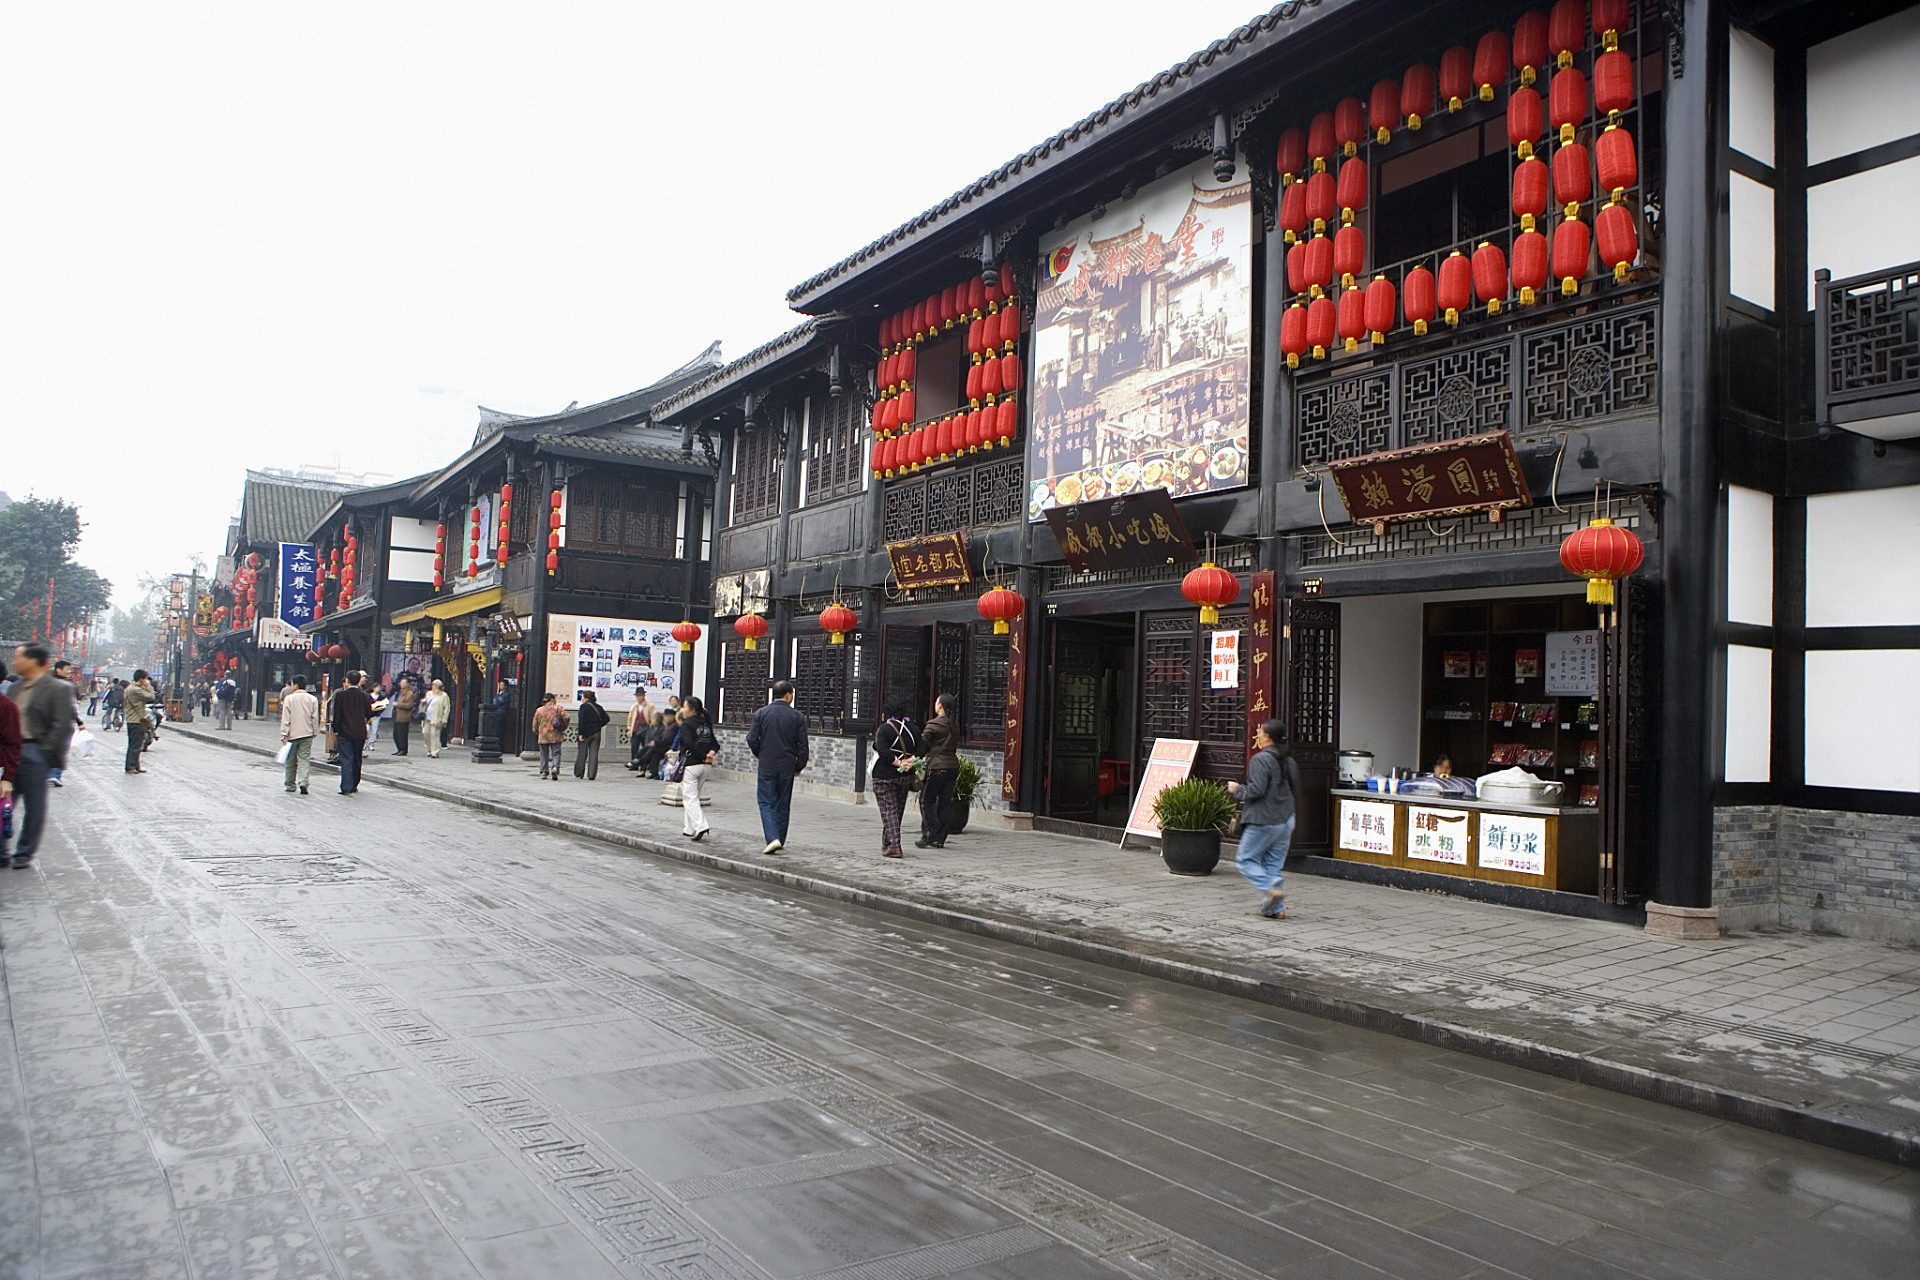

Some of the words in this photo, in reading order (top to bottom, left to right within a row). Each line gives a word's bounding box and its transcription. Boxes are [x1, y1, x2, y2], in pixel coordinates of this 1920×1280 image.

[1072, 214, 1204, 301] 成都名堂
[1066, 512, 1180, 556] 成都小吃城
[1215, 634, 1236, 650] 招聘
[1572, 634, 1599, 645] 今日
[1415, 811, 1440, 832] 红糖
[1415, 833, 1455, 852] 冰粉
